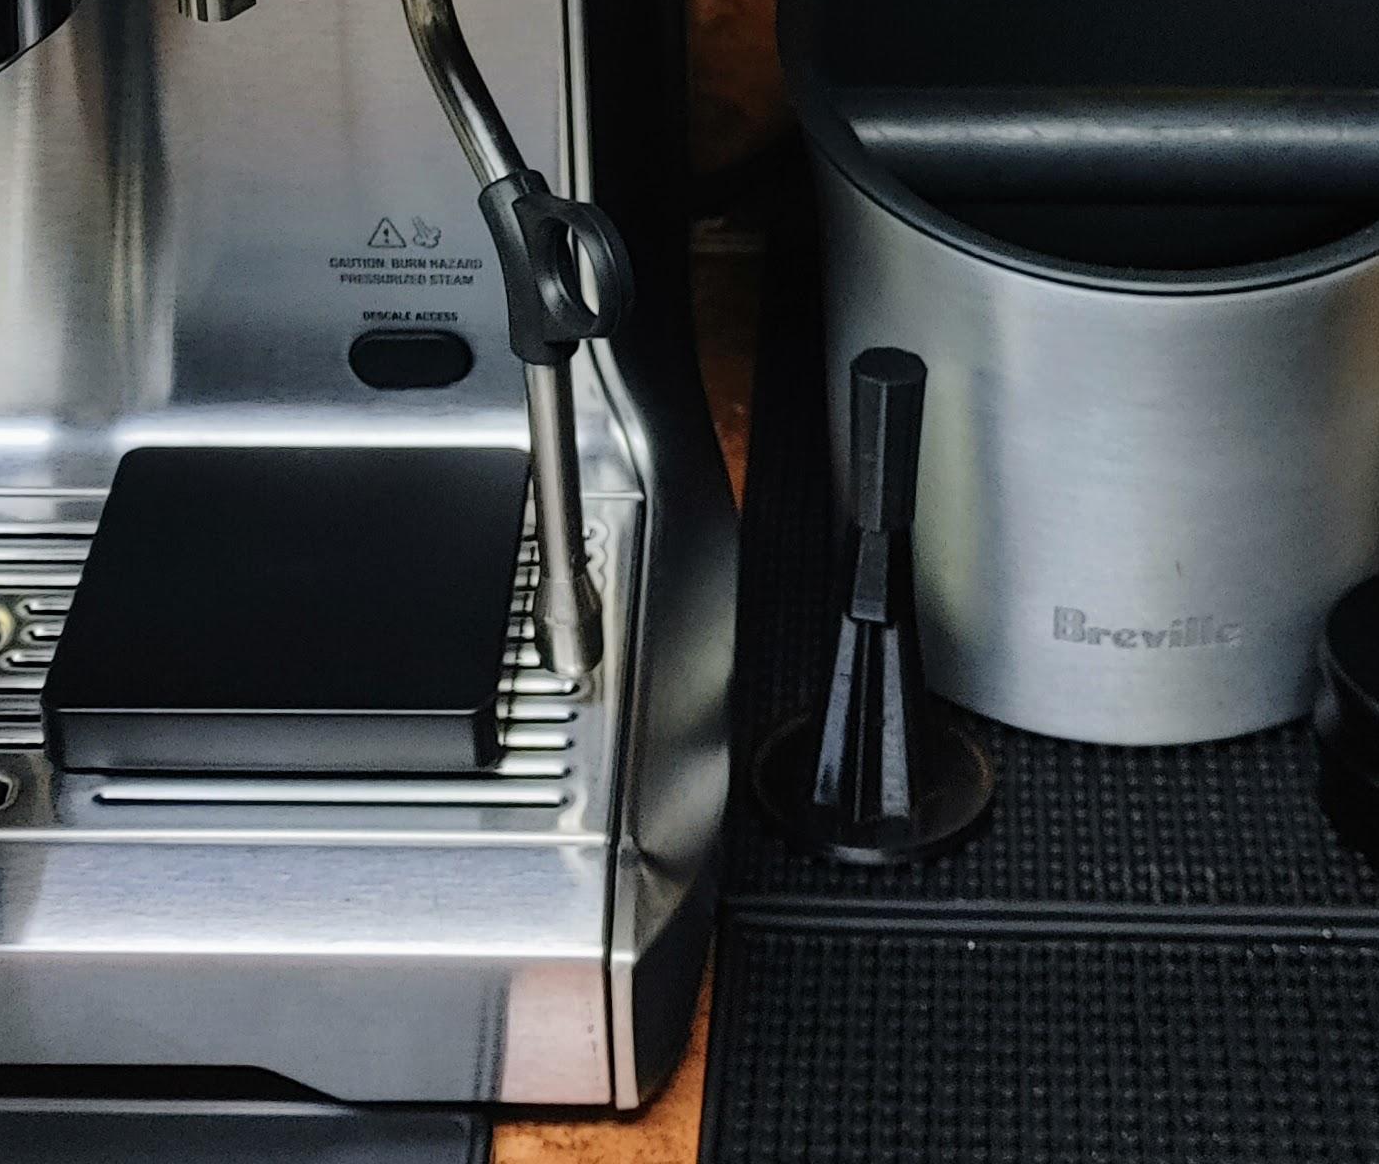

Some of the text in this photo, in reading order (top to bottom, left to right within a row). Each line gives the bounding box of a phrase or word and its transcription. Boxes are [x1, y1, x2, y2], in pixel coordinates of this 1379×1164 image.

[391, 257, 427, 269] BURN
[429, 257, 483, 270] HAZARD
[340, 273, 474, 285] PRESSURIZED STEAM
[363, 311, 459, 323] DESCALE ACCESS
[1052, 605, 1244, 650] Breville
